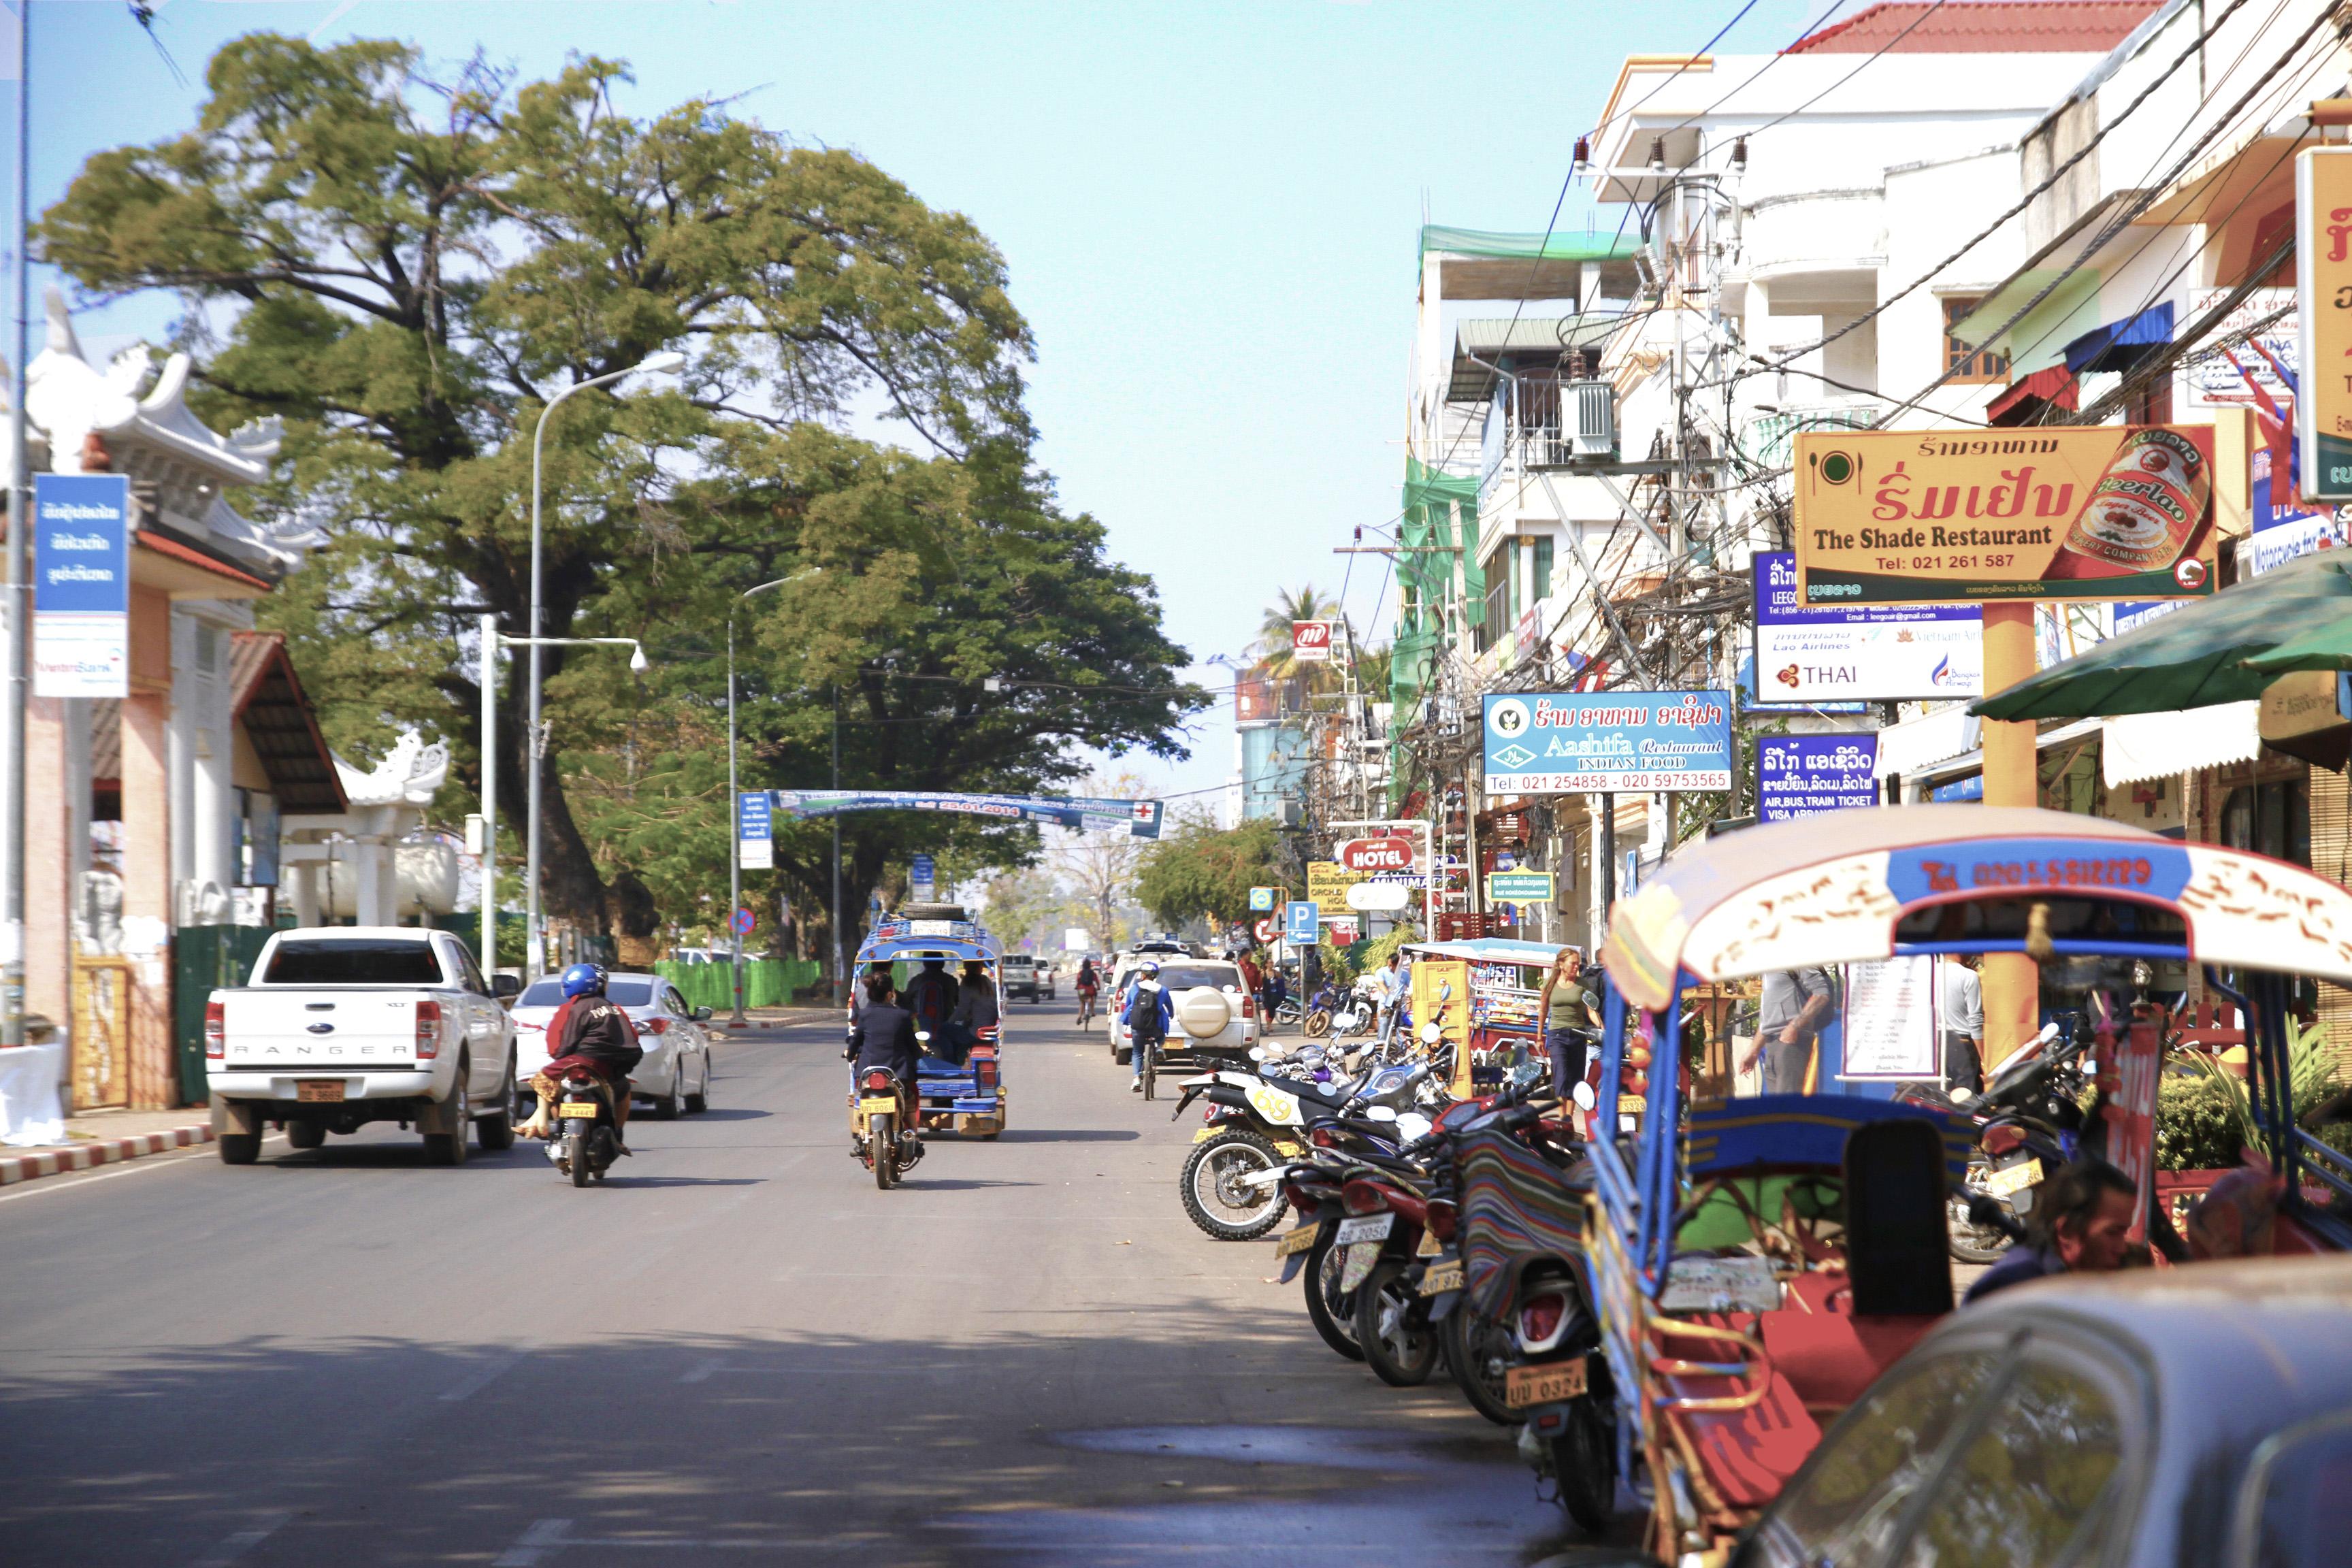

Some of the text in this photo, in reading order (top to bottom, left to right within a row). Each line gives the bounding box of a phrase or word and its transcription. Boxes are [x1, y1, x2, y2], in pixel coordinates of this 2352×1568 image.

[2130, 506, 2160, 525] Beer
[1814, 525, 2053, 550] The Shade Restaurant
[2104, 546, 2154, 562] COMPANY
[2254, 534, 2300, 574] Motorcycle
[2303, 529, 2317, 555] for
[1876, 554, 2015, 570] Tel: 021 261 587
[1870, 612, 1936, 621] leegoair@gmail.com
[1916, 630, 1961, 642] Vietnam
[1773, 642, 1850, 651] Lao Airlines
[1803, 666, 1857, 684] THAI
[1945, 676, 1972, 689] Airways
[1544, 732, 1723, 757] Aashifa Restaurant
[1578, 756, 1686, 770] INDIAN FOOD
[1490, 777, 1517, 789] Tel:
[1522, 777, 1548, 789] 021
[1554, 775, 1607, 789] 254858
[1622, 774, 1649, 787] 020
[1654, 773, 1726, 787] 59753565
[939, 801, 1019, 817] 25.01.2014
[1765, 796, 1872, 808] AIR,BUS,TRAIN TICKET
[1767, 809, 1792, 820] VISA
[1353, 850, 1404, 867] HOTEL
[1311, 888, 1343, 896] ORCHD
[1295, 906, 1309, 928] P
[234, 1045, 407, 1055] RANGER
[1253, 1090, 1292, 1122] 69
